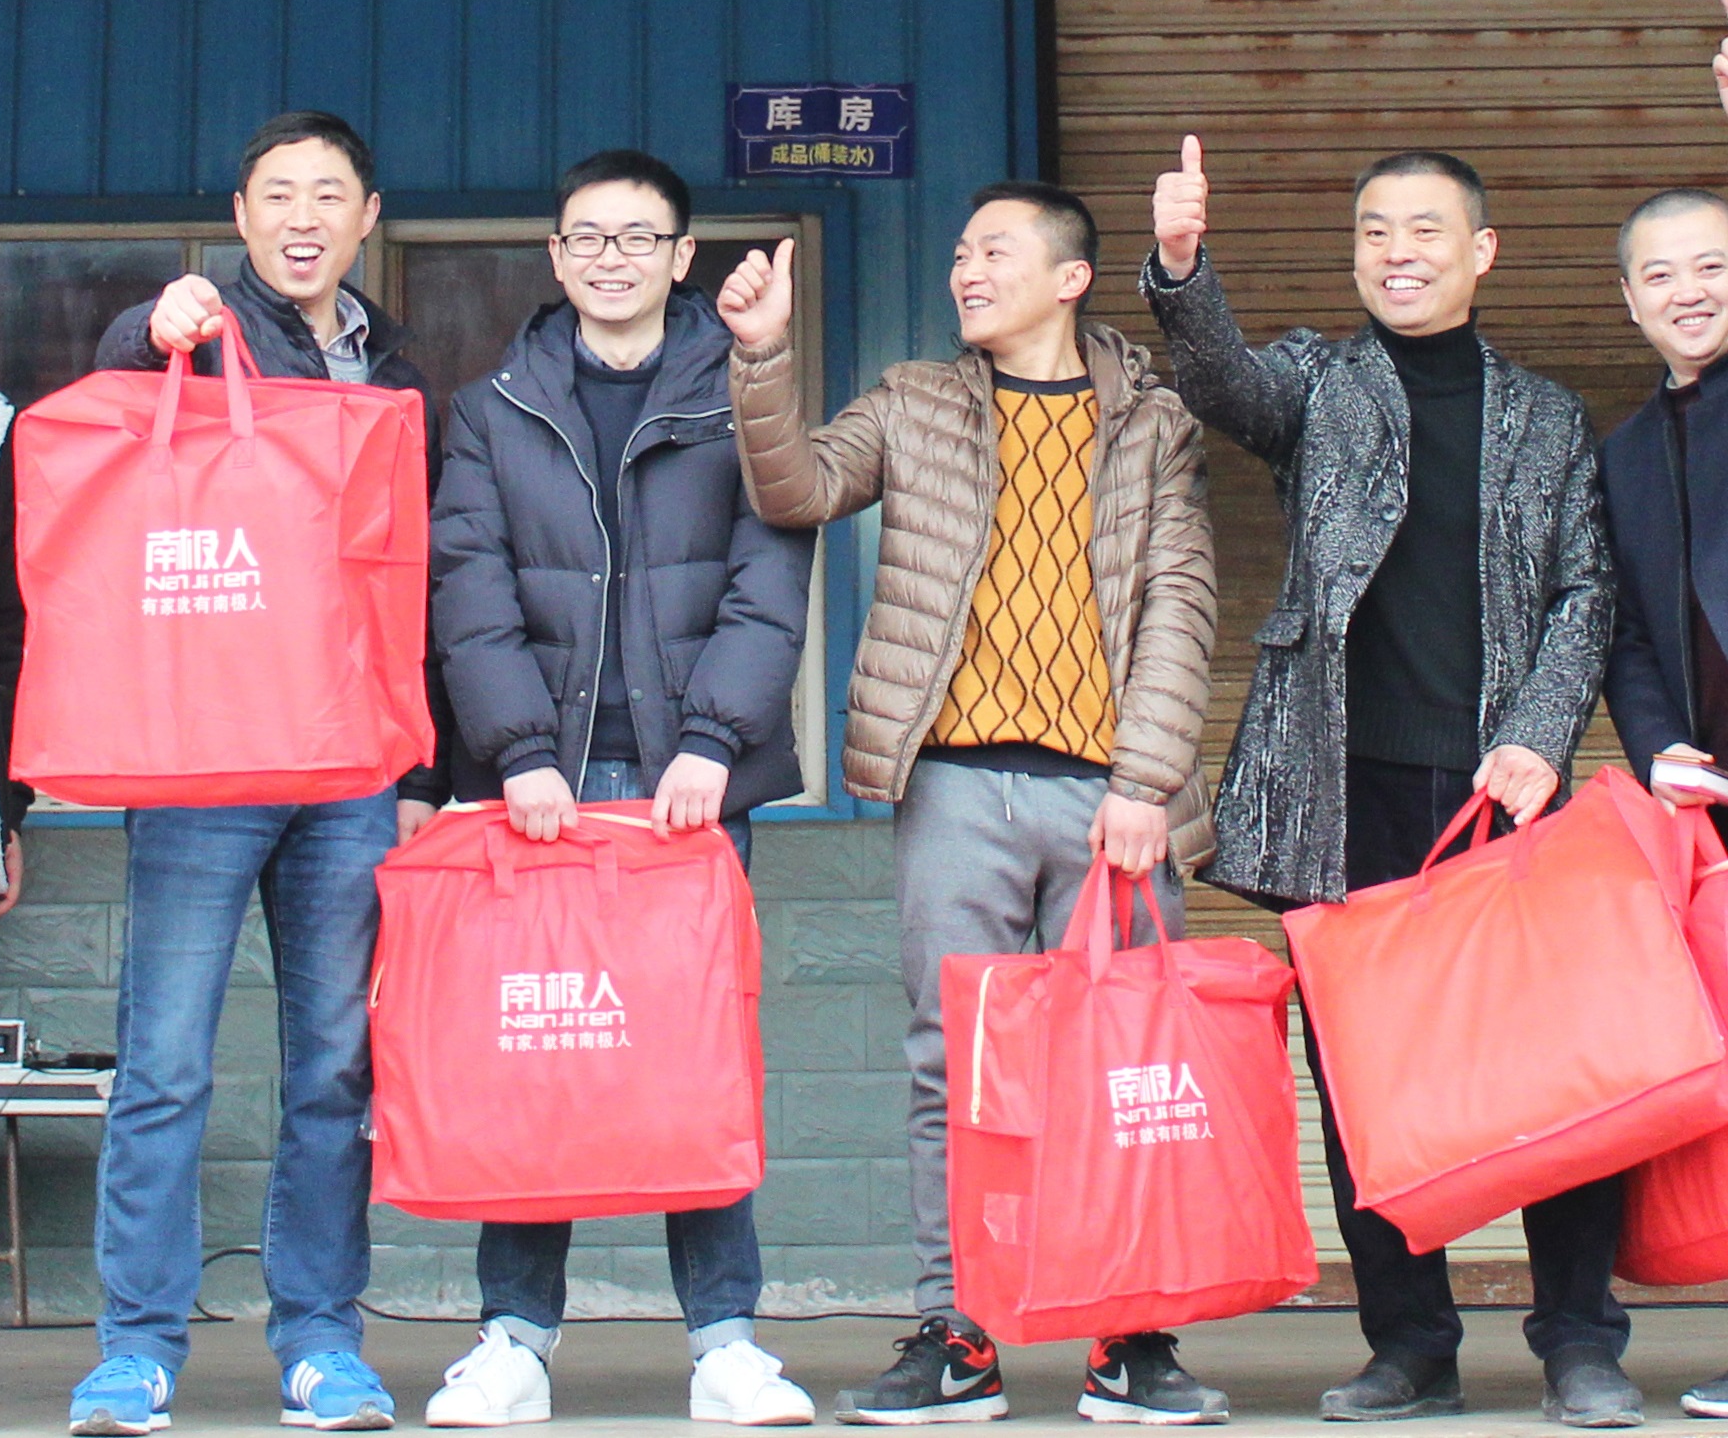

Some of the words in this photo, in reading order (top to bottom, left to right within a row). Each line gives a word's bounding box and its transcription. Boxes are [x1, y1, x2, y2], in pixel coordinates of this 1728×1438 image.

[766, 96, 874, 131] 库房
[770, 142, 875, 167] 成品(桶装水)
[145, 528, 260, 573] 南极人
[500, 971, 624, 1012] 南极人
[1107, 1062, 1205, 1109] 南极人
